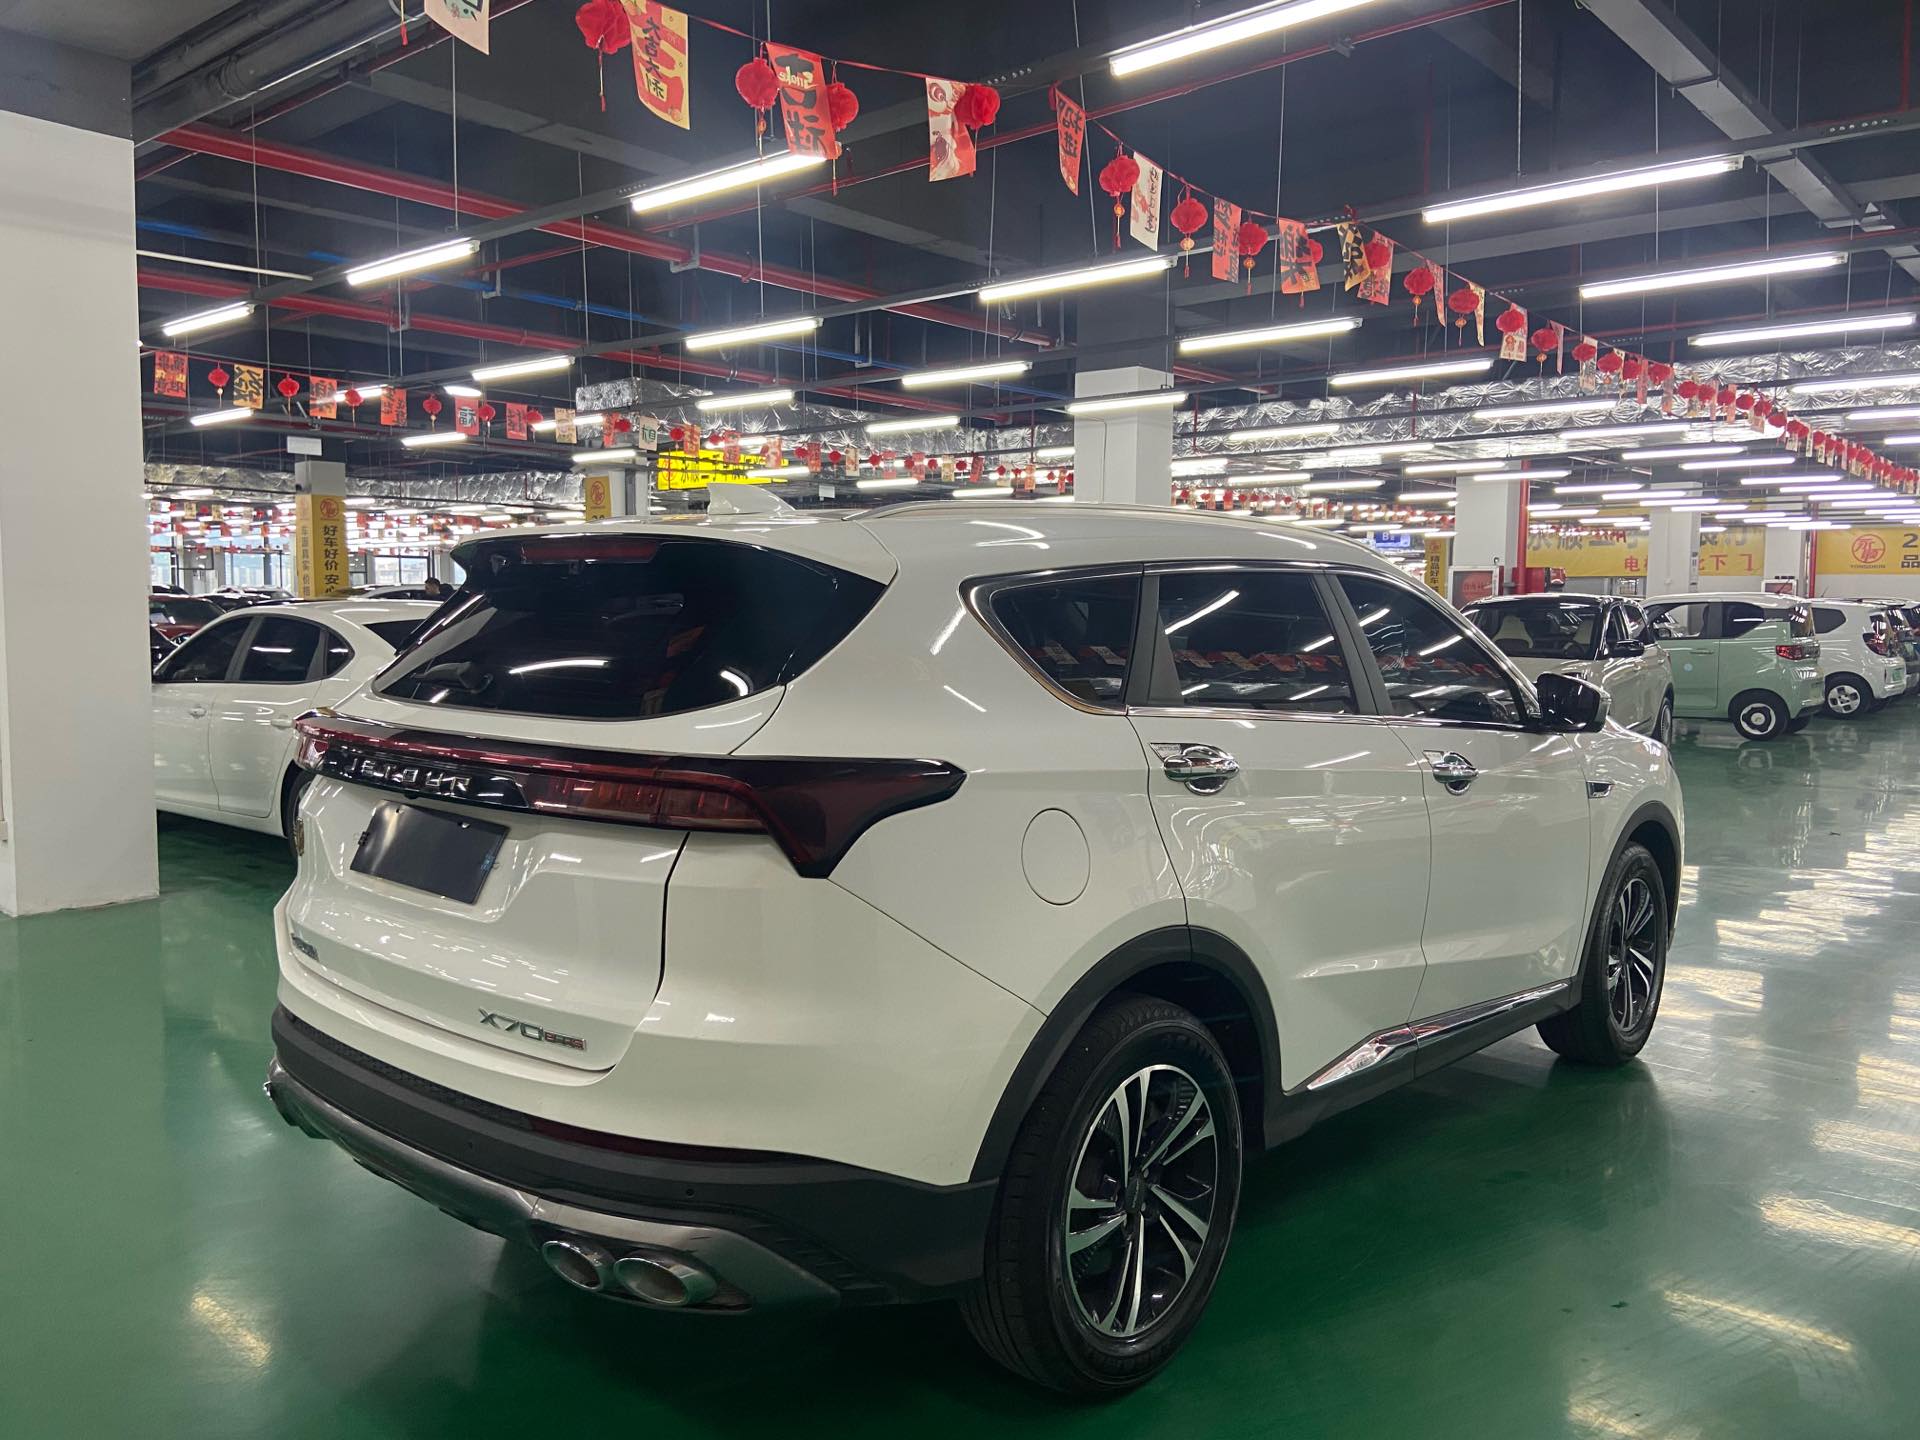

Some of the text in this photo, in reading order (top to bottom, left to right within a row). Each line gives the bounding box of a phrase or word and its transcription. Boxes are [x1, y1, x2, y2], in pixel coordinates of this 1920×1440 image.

[322, 525, 339, 571] 好车好价
[478, 1007, 544, 1042] X70
